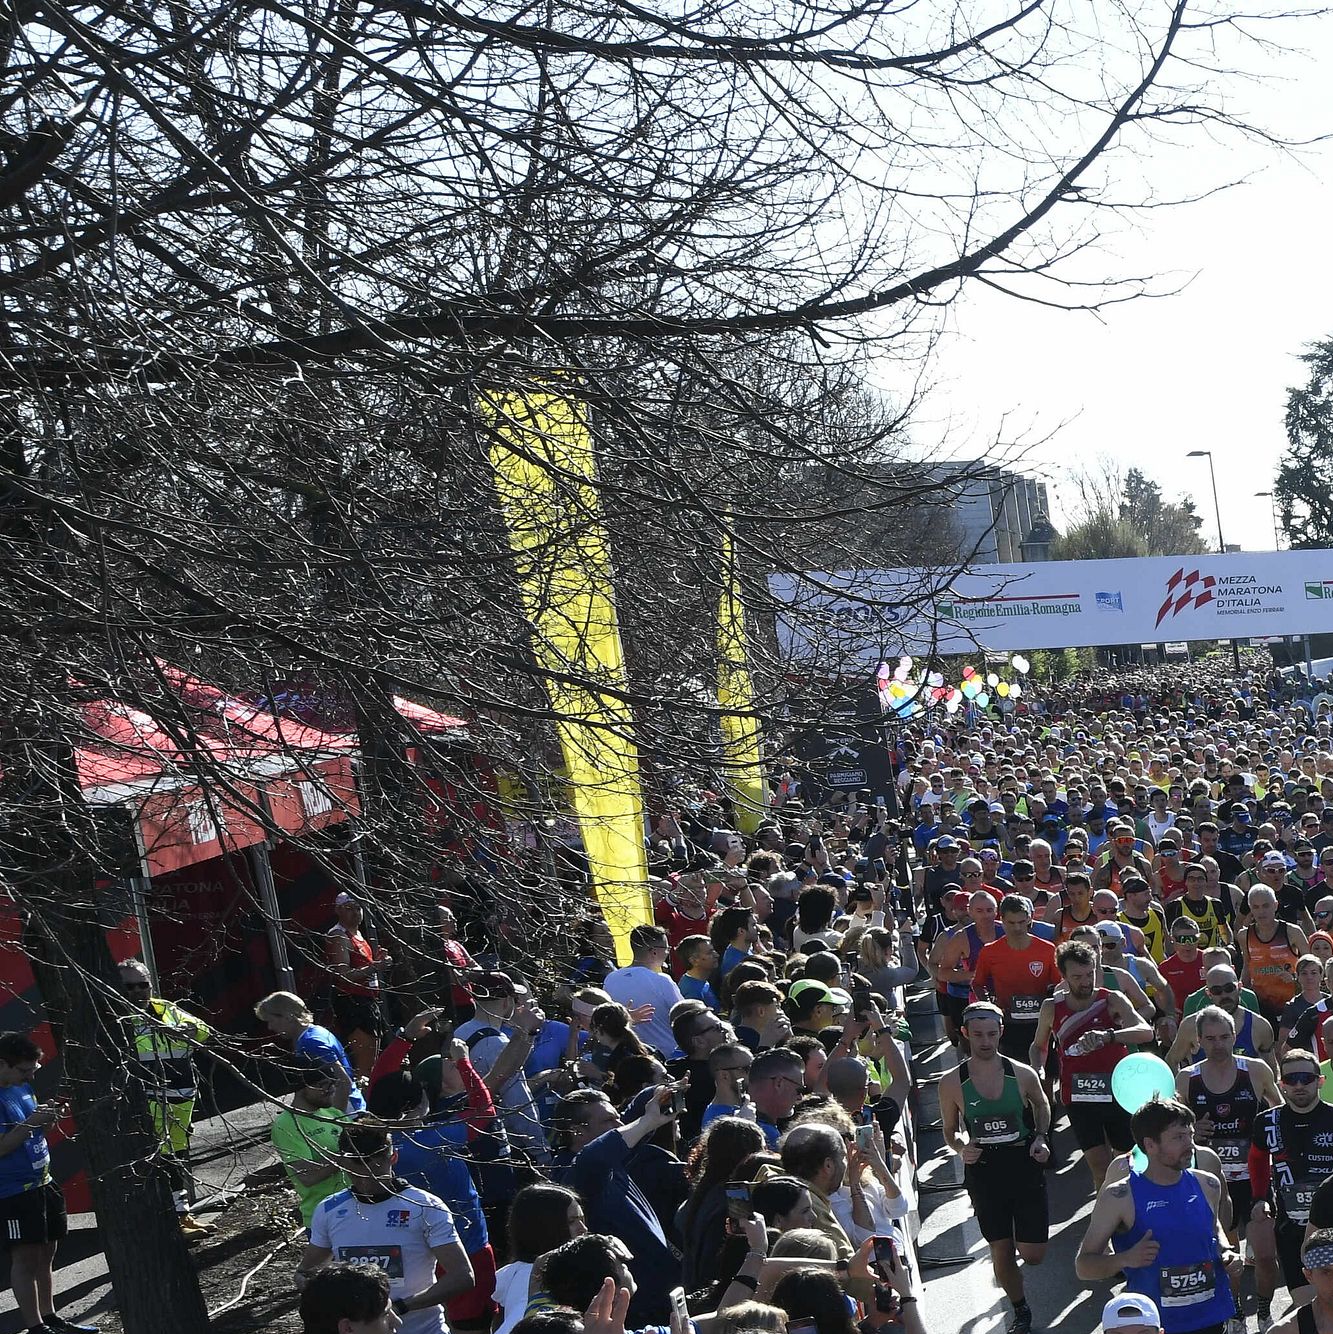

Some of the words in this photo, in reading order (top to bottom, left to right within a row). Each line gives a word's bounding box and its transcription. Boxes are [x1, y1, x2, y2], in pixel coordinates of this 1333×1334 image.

[1218, 575, 1257, 585] MEZZA
[1217, 585, 1283, 596] MARATONA
[1216, 597, 1261, 608] D'ITALIA
[1015, 999, 1040, 1010] 5494
[1076, 1079, 1106, 1090] 5424
[983, 1120, 1007, 1132] 605
[1217, 1147, 1240, 1158] 276
[1170, 1272, 1207, 1289] 5754
